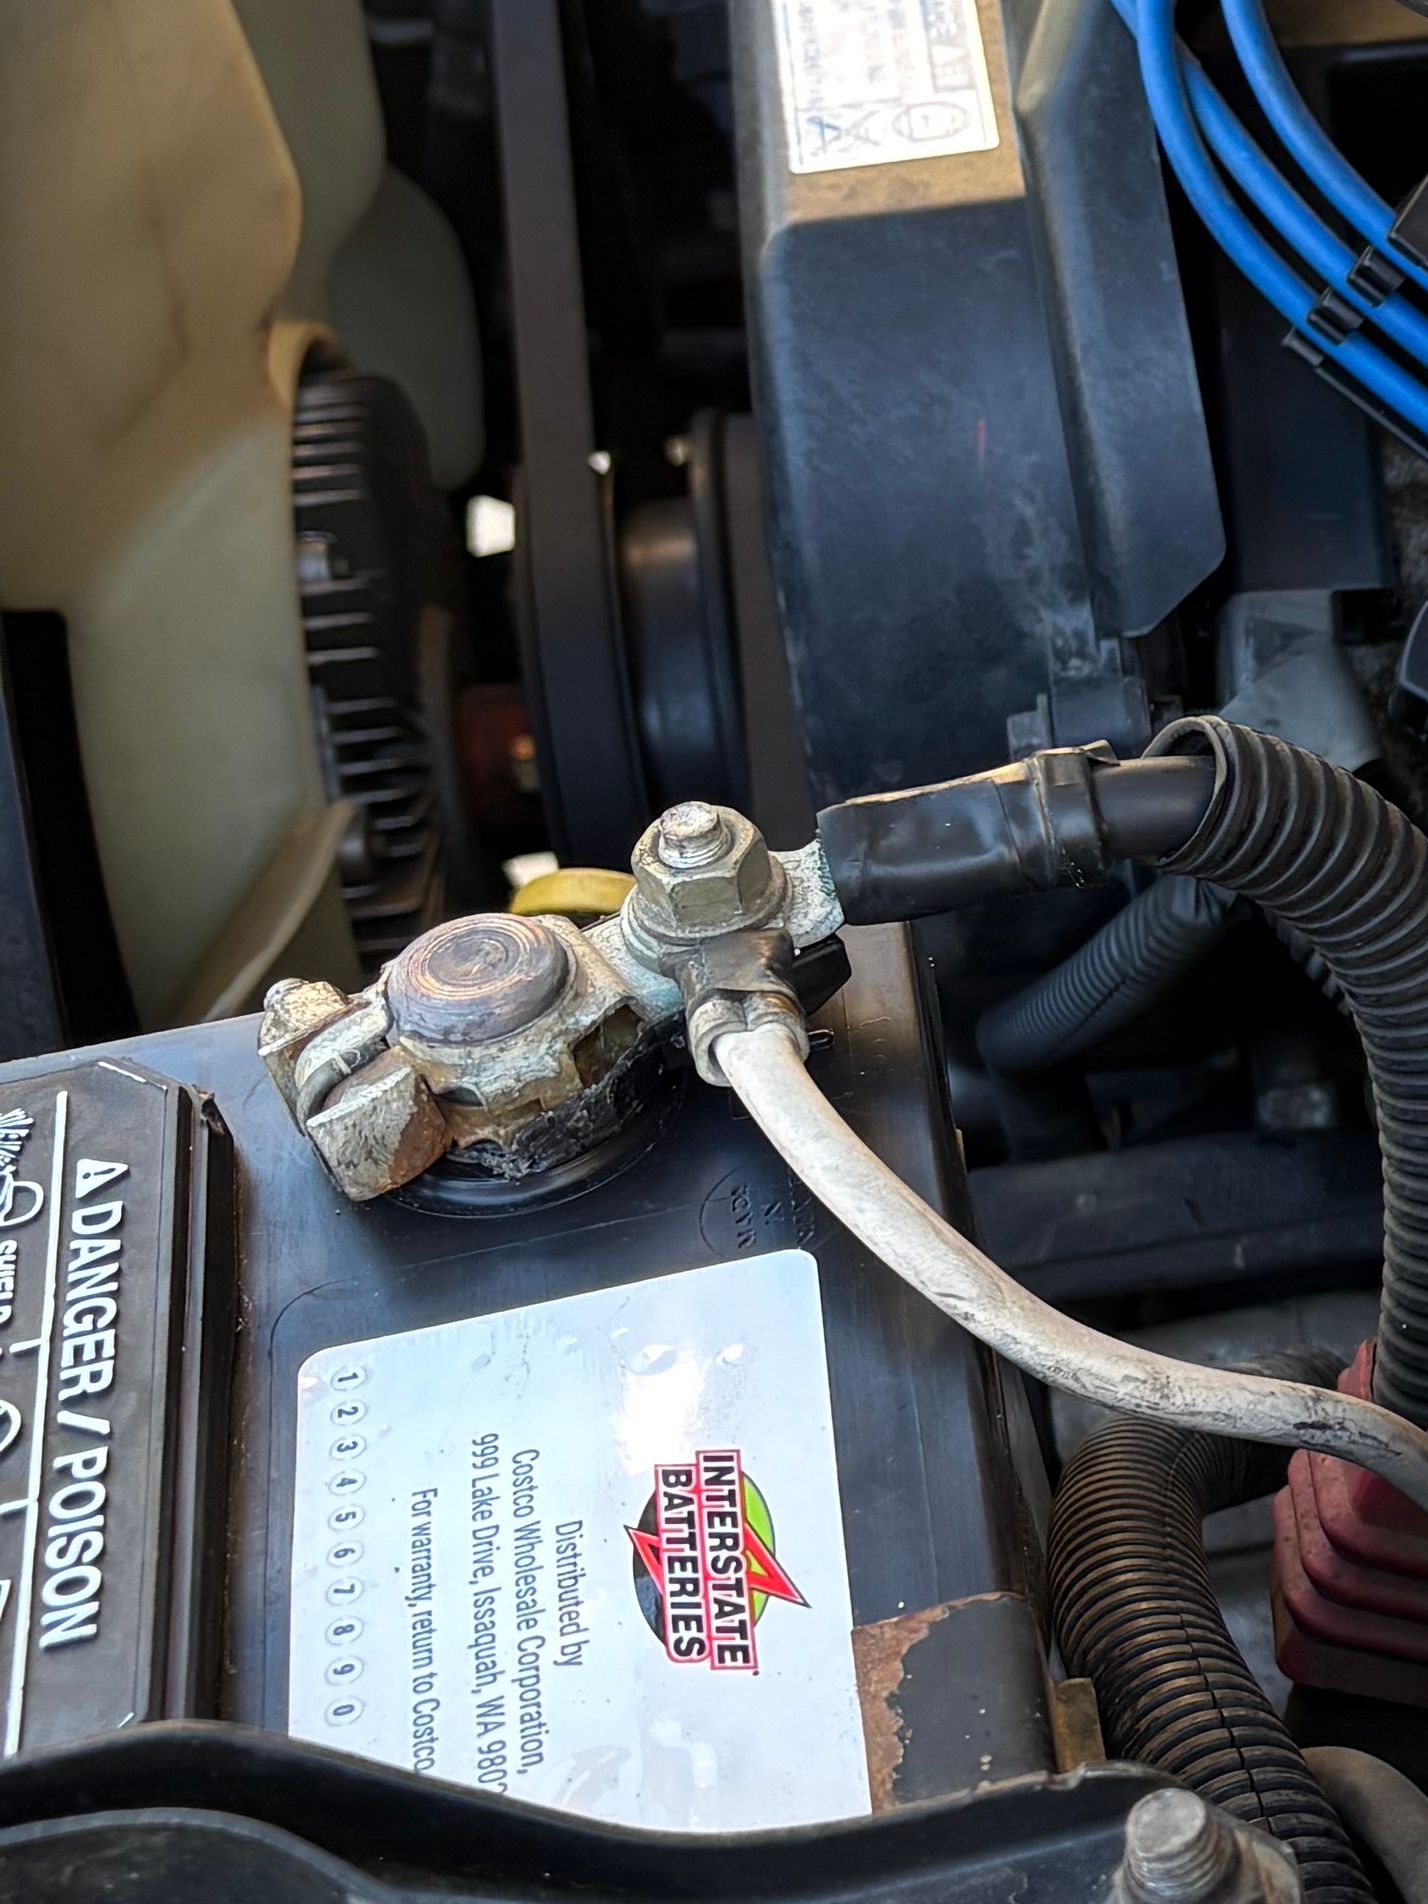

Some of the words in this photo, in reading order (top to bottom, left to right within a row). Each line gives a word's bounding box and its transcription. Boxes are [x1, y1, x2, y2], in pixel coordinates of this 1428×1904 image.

[58, 1200, 125, 1402] DANGER
[339, 1371, 360, 1383] 1
[57, 1408, 111, 1437] /
[337, 1406, 359, 1419] 2
[337, 1441, 359, 1454] 3
[471, 1433, 500, 1469] 999
[336, 1476, 358, 1489] 4
[471, 1474, 501, 1521] Lake
[511, 1448, 541, 1518] Costco
[335, 1510, 357, 1523] 5
[411, 1487, 438, 1516] For
[38, 1445, 109, 1651] POISON
[334, 1547, 356, 1560] 6
[404, 1520, 435, 1608] warranty,
[468, 1525, 501, 1585] Drive,
[661, 1468, 706, 1658] BATTERIES
[702, 1455, 750, 1665] INTERSTATE
[333, 1583, 356, 1595] 7
[512, 1520, 545, 1631] Wholesale
[555, 1519, 589, 1638] Distributed
[332, 1623, 355, 1637] 8
[411, 1609, 434, 1669] return
[468, 1587, 505, 1695] Issaquah,
[332, 1663, 355, 1677] 9
[552, 1640, 590, 1667] by
[411, 1672, 435, 1694] to
[332, 1703, 355, 1717] 0
[474, 1695, 505, 1738] WA
[515, 1635, 550, 1775] Corporation,
